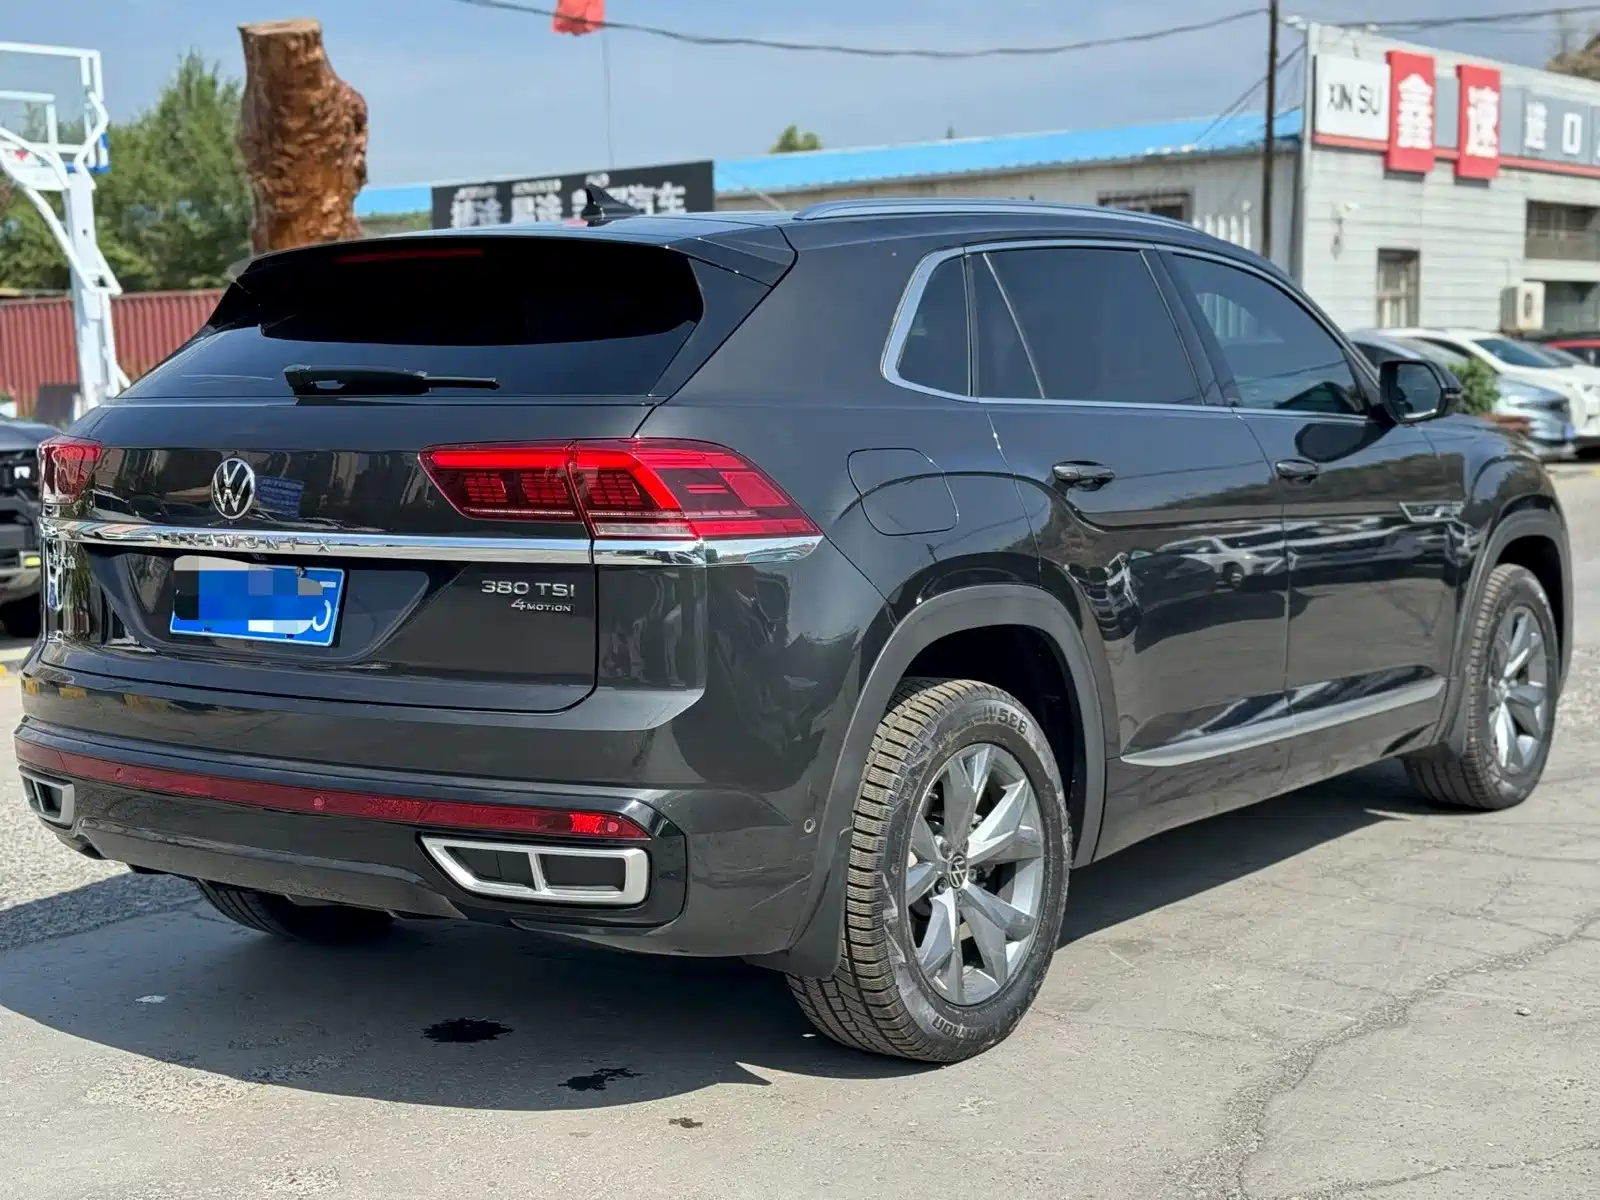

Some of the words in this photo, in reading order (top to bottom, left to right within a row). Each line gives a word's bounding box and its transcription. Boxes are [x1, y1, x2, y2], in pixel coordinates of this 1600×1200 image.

[1327, 83, 1353, 112] XIN
[1360, 84, 1384, 115] SU
[316, 537, 331, 553] X
[481, 580, 530, 595] 380
[534, 582, 575, 597] TSI
